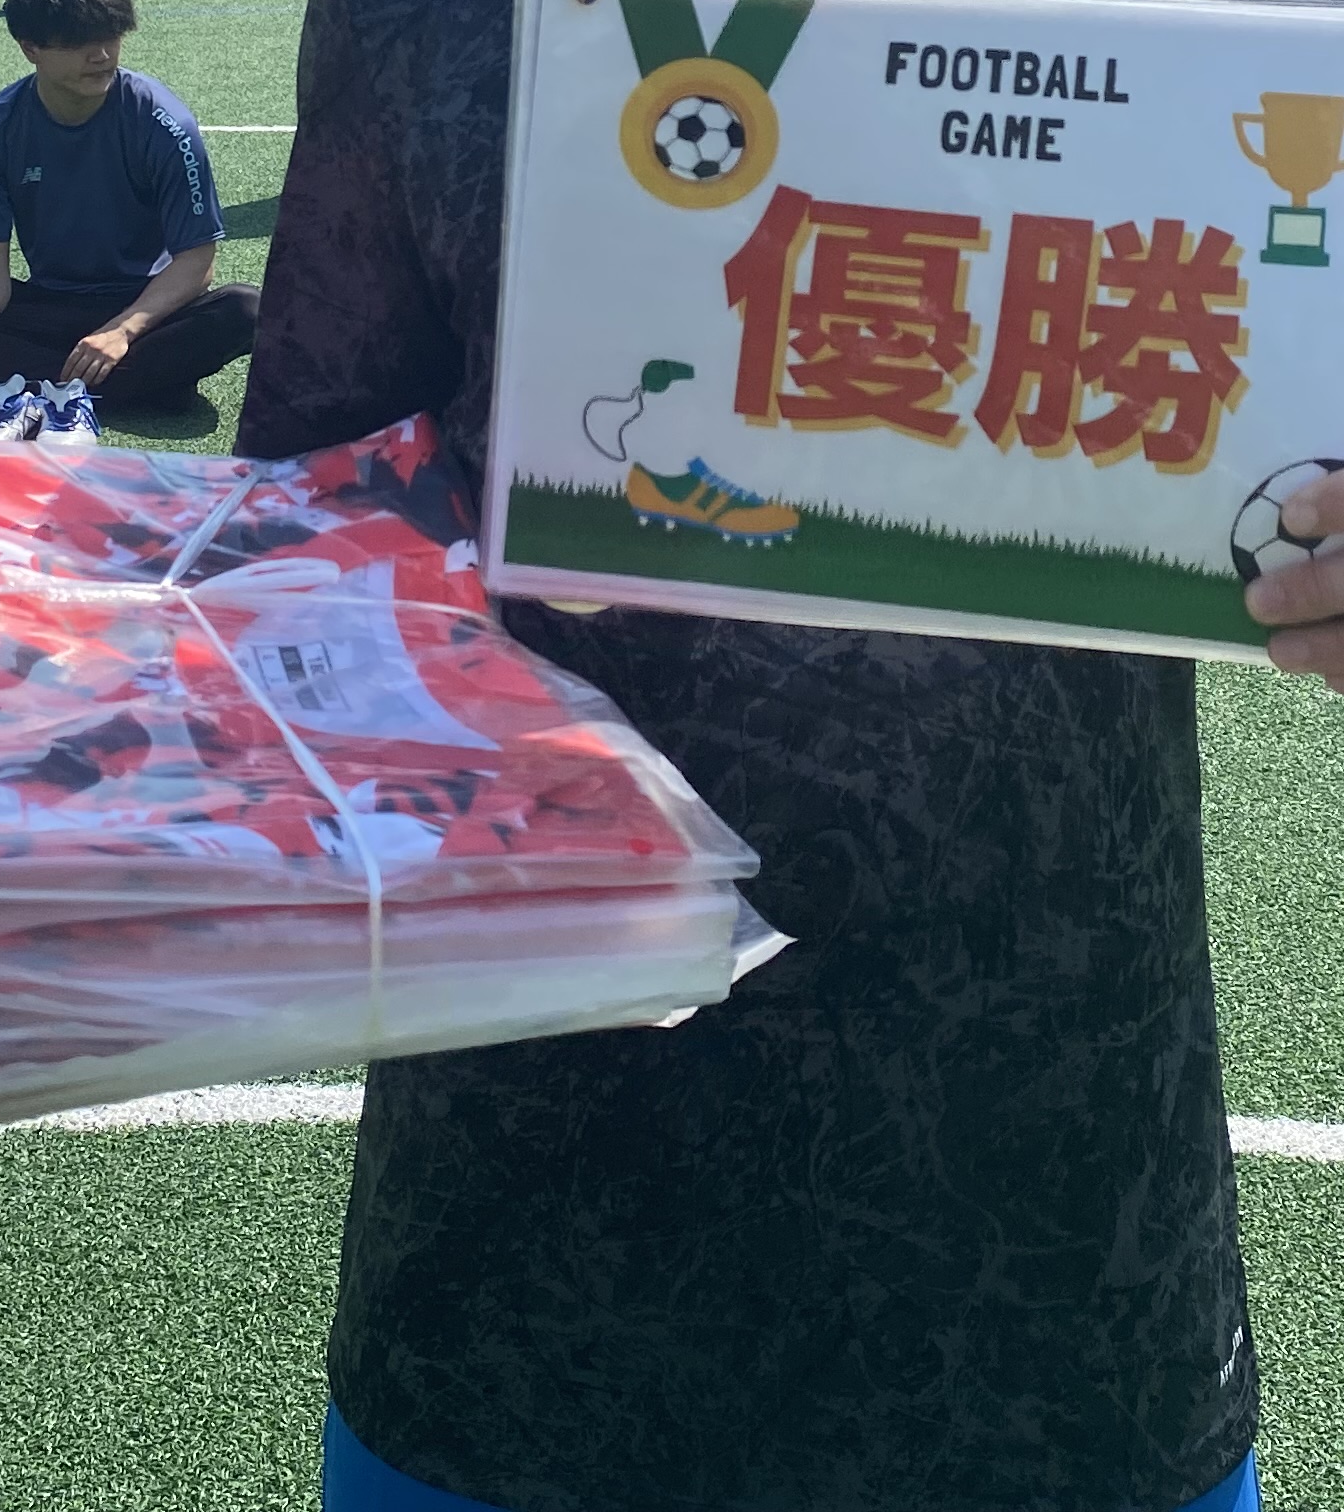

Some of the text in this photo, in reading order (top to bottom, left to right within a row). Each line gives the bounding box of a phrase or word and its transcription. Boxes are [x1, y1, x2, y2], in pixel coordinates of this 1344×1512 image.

[884, 41, 1131, 105] FOOTBALL
[939, 110, 1067, 164] GAME
[722, 183, 1252, 476] 優勝
